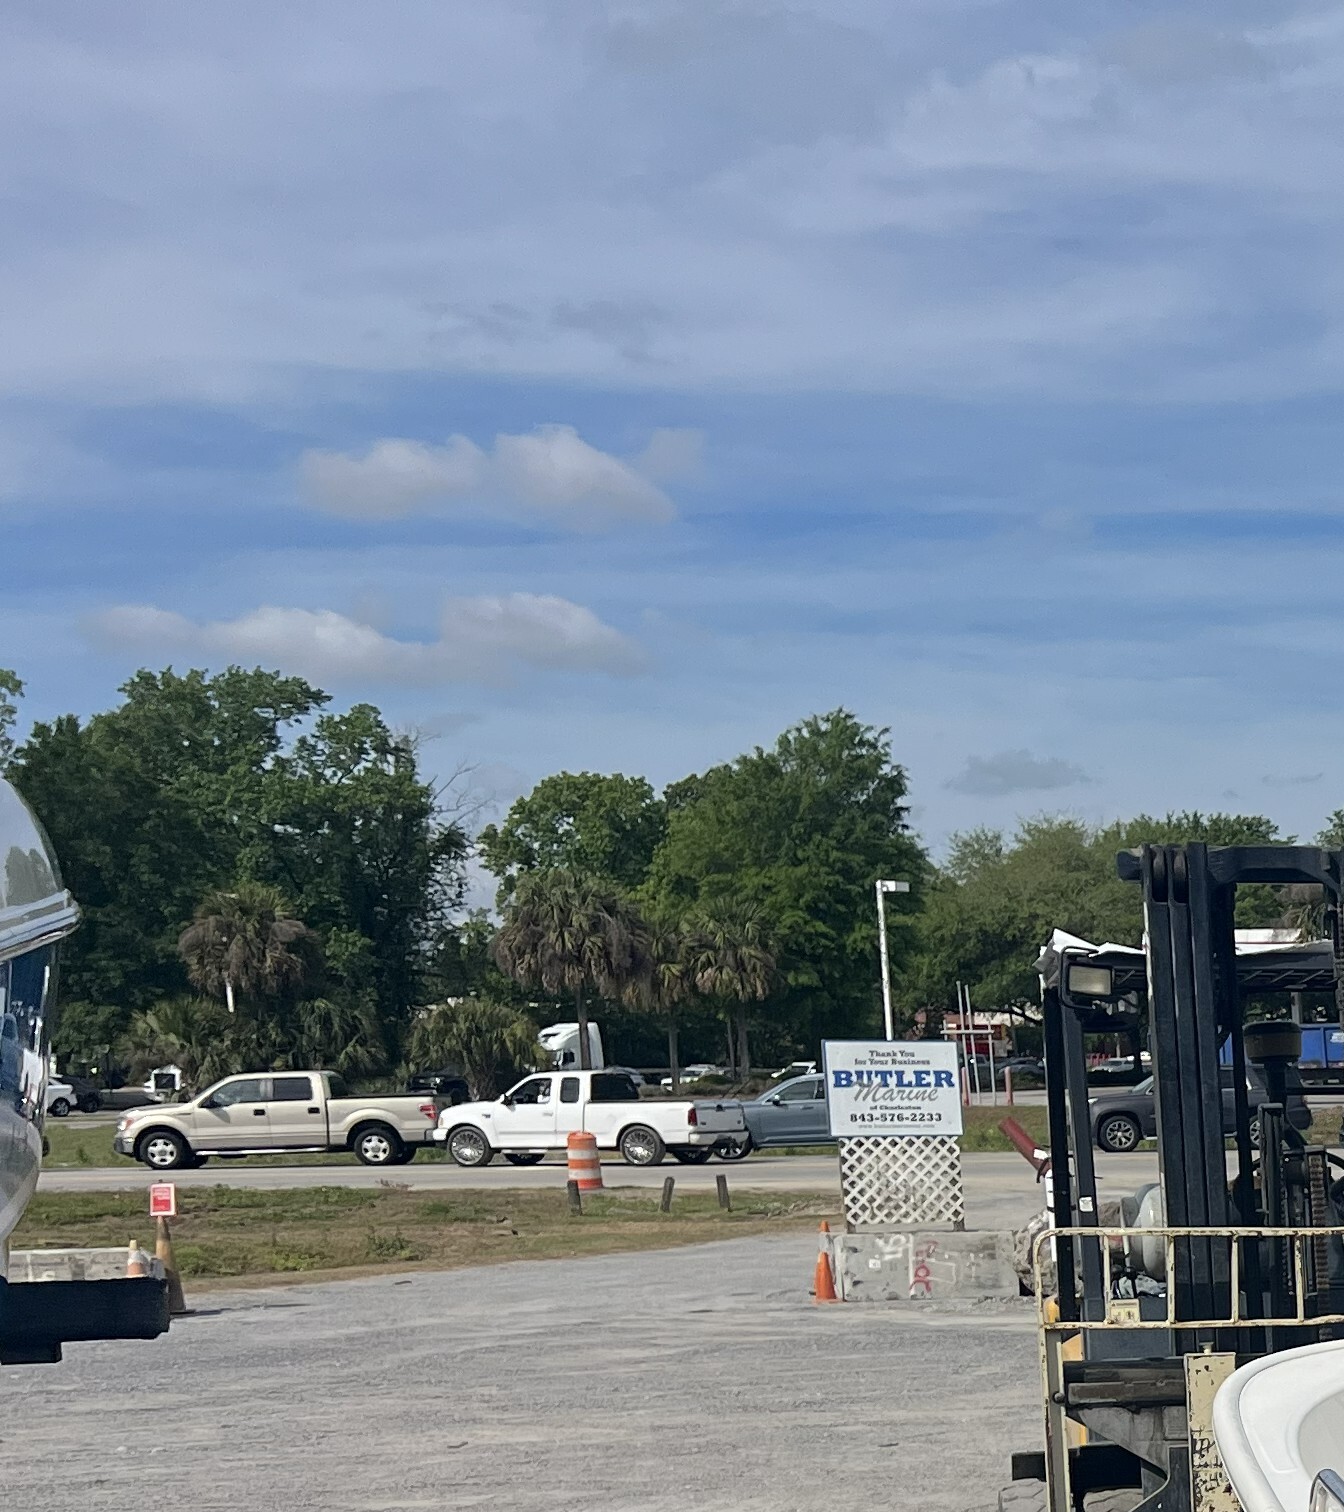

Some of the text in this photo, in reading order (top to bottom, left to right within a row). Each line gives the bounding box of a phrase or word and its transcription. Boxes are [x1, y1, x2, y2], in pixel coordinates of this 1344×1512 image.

[833, 1070, 955, 1088] BUTLER
[853, 1080, 939, 1102] Marine
[850, 1113, 942, 1122] 843-576-2233
